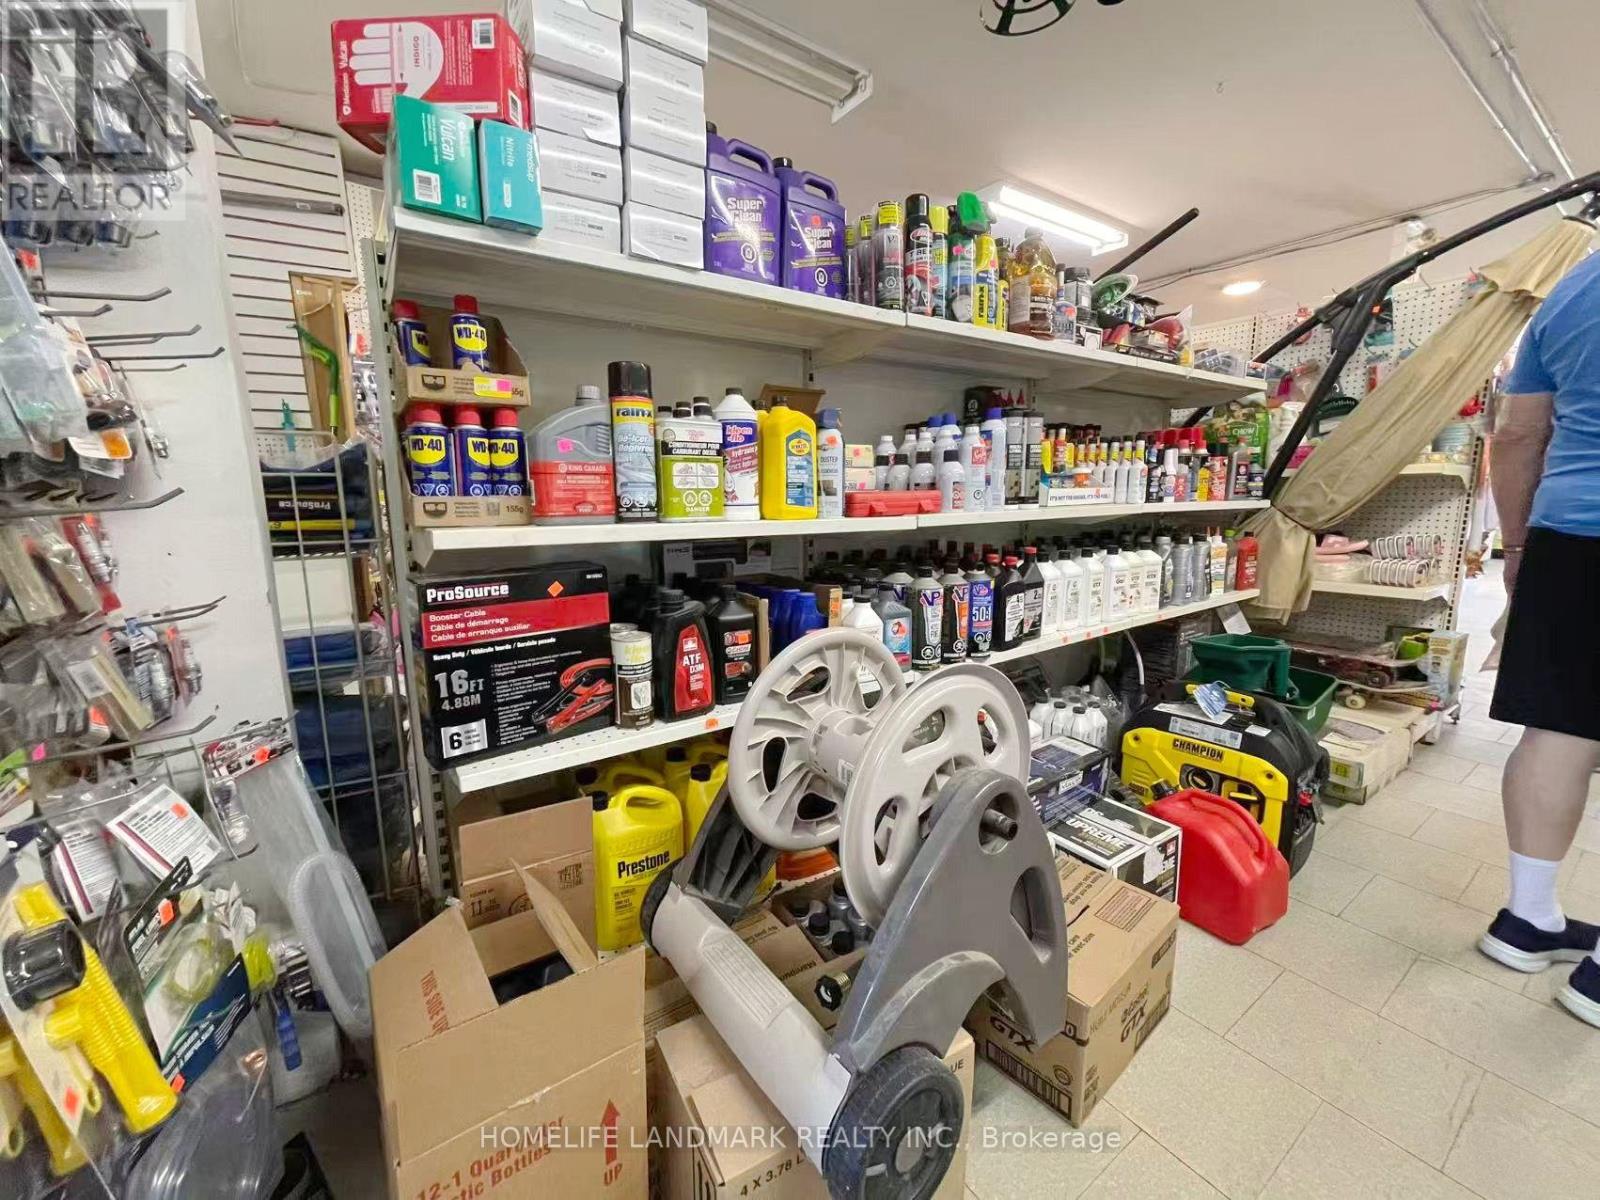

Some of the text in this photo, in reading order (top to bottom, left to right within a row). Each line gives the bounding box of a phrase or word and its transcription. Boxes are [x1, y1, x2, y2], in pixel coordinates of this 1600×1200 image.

[440, 117, 456, 162] Vulcan
[727, 197, 762, 211] Super
[733, 210, 762, 222] Clean
[804, 227, 832, 238] Super
[455, 326, 487, 342] WD-40
[411, 438, 443, 452] WD-40
[426, 583, 510, 603] ProSource
[922, 591, 941, 606] VP
[429, 610, 486, 622] Booster Cable
[467, 617, 509, 628] démarrage
[972, 606, 991, 621] 50:1
[456, 631, 466, 639] de
[468, 628, 503, 638] arranque
[505, 623, 531, 632] auxiliar
[683, 653, 701, 666] ATF
[441, 694, 481, 712] 4.88M
[449, 732, 462, 750] 6
[1172, 738, 1224, 761] CHAMPION
[1065, 819, 1127, 849] UPREME
[617, 850, 670, 879] Prestone
[420, 970, 438, 998] THIS
[426, 993, 445, 1020] SIDE
[990, 1017, 1034, 1053] GTX
[490, 1143, 553, 1187] Bottles
[603, 1163, 624, 1187] UP
[740, 1183, 749, 1198] 4
[765, 1162, 793, 1183] 3.78
